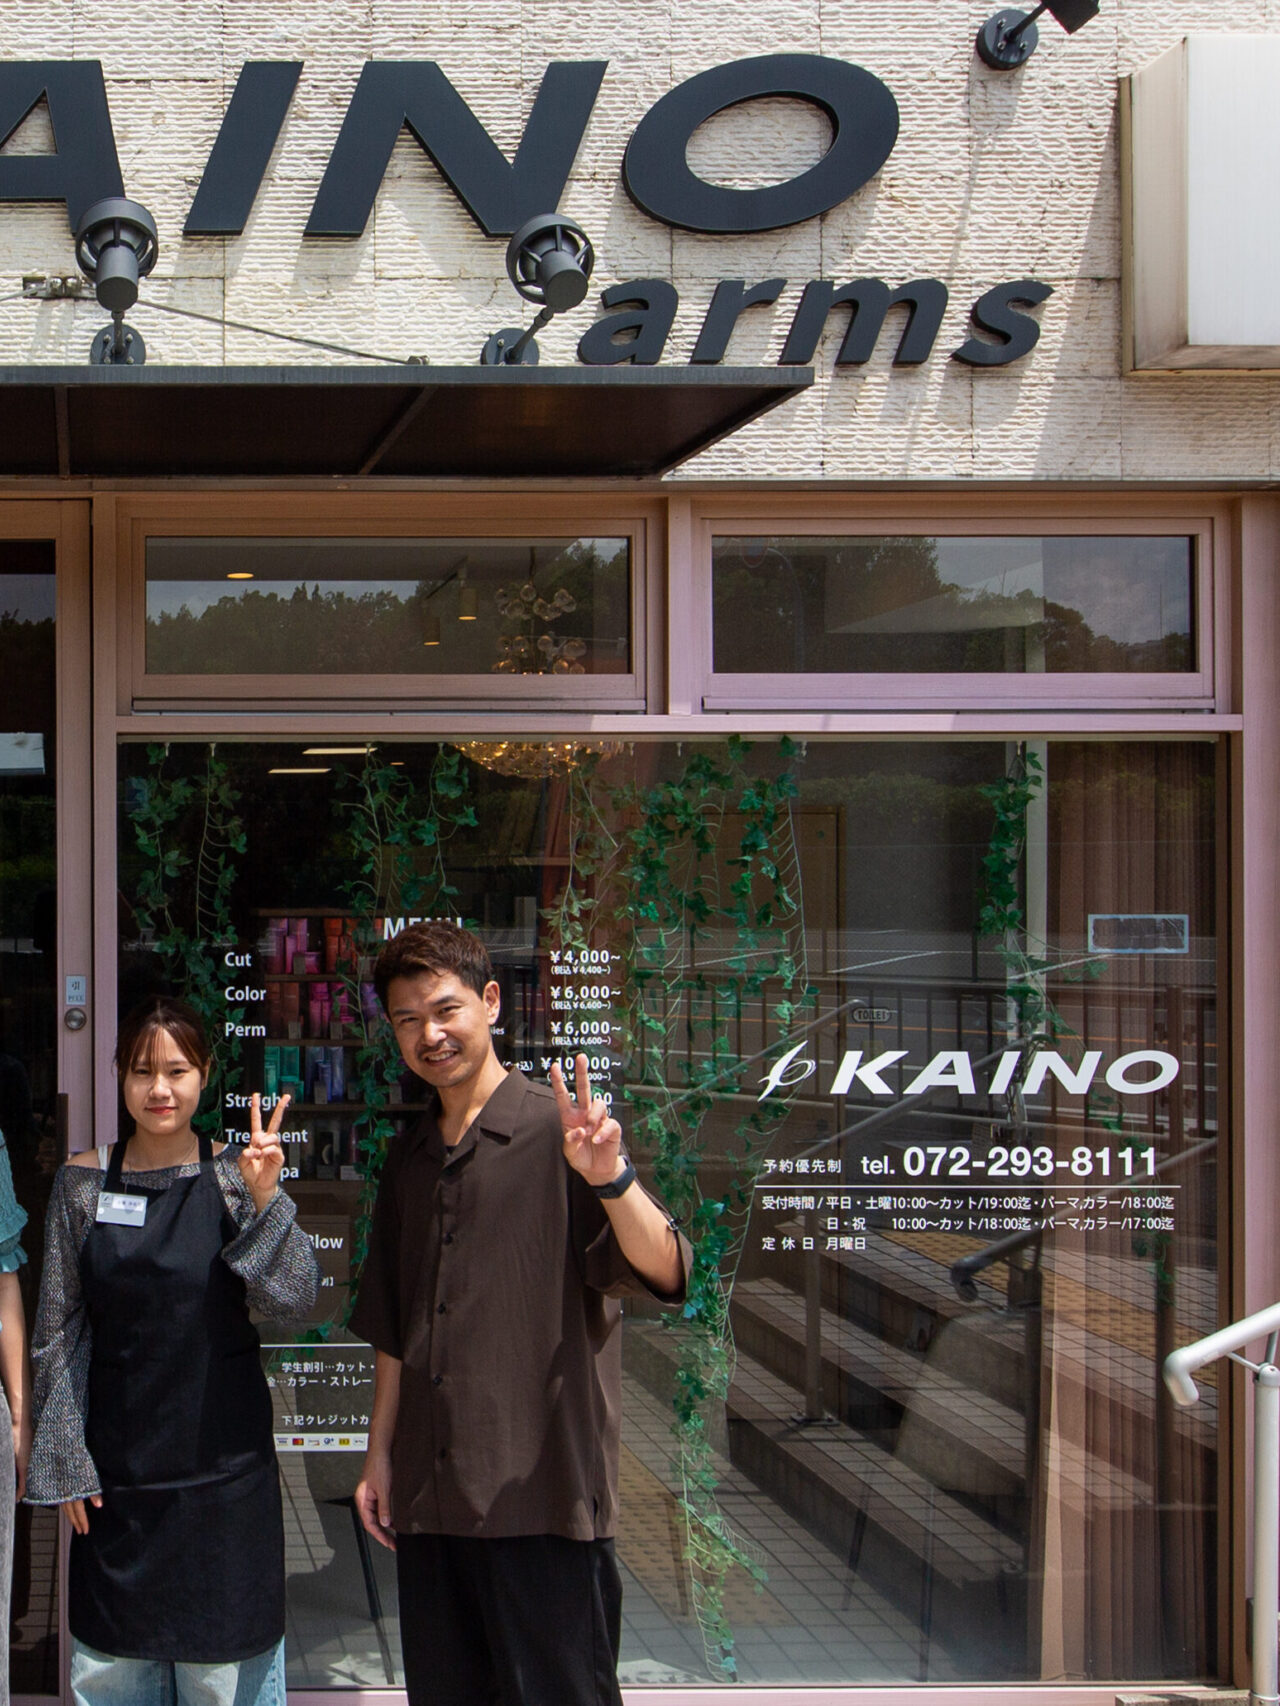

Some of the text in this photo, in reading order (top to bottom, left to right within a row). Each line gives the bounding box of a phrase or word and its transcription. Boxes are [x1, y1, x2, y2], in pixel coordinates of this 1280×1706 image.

[577, 277, 1056, 367] arms
[224, 952, 252, 967] Cut
[224, 986, 266, 1001] Color
[225, 1022, 266, 1037] Perm
[829, 1050, 1180, 1095] KAINO
[763, 1146, 1156, 1177] 予約優先制 tel. 072-293-8111
[825, 1237, 866, 1250] 月曜日
